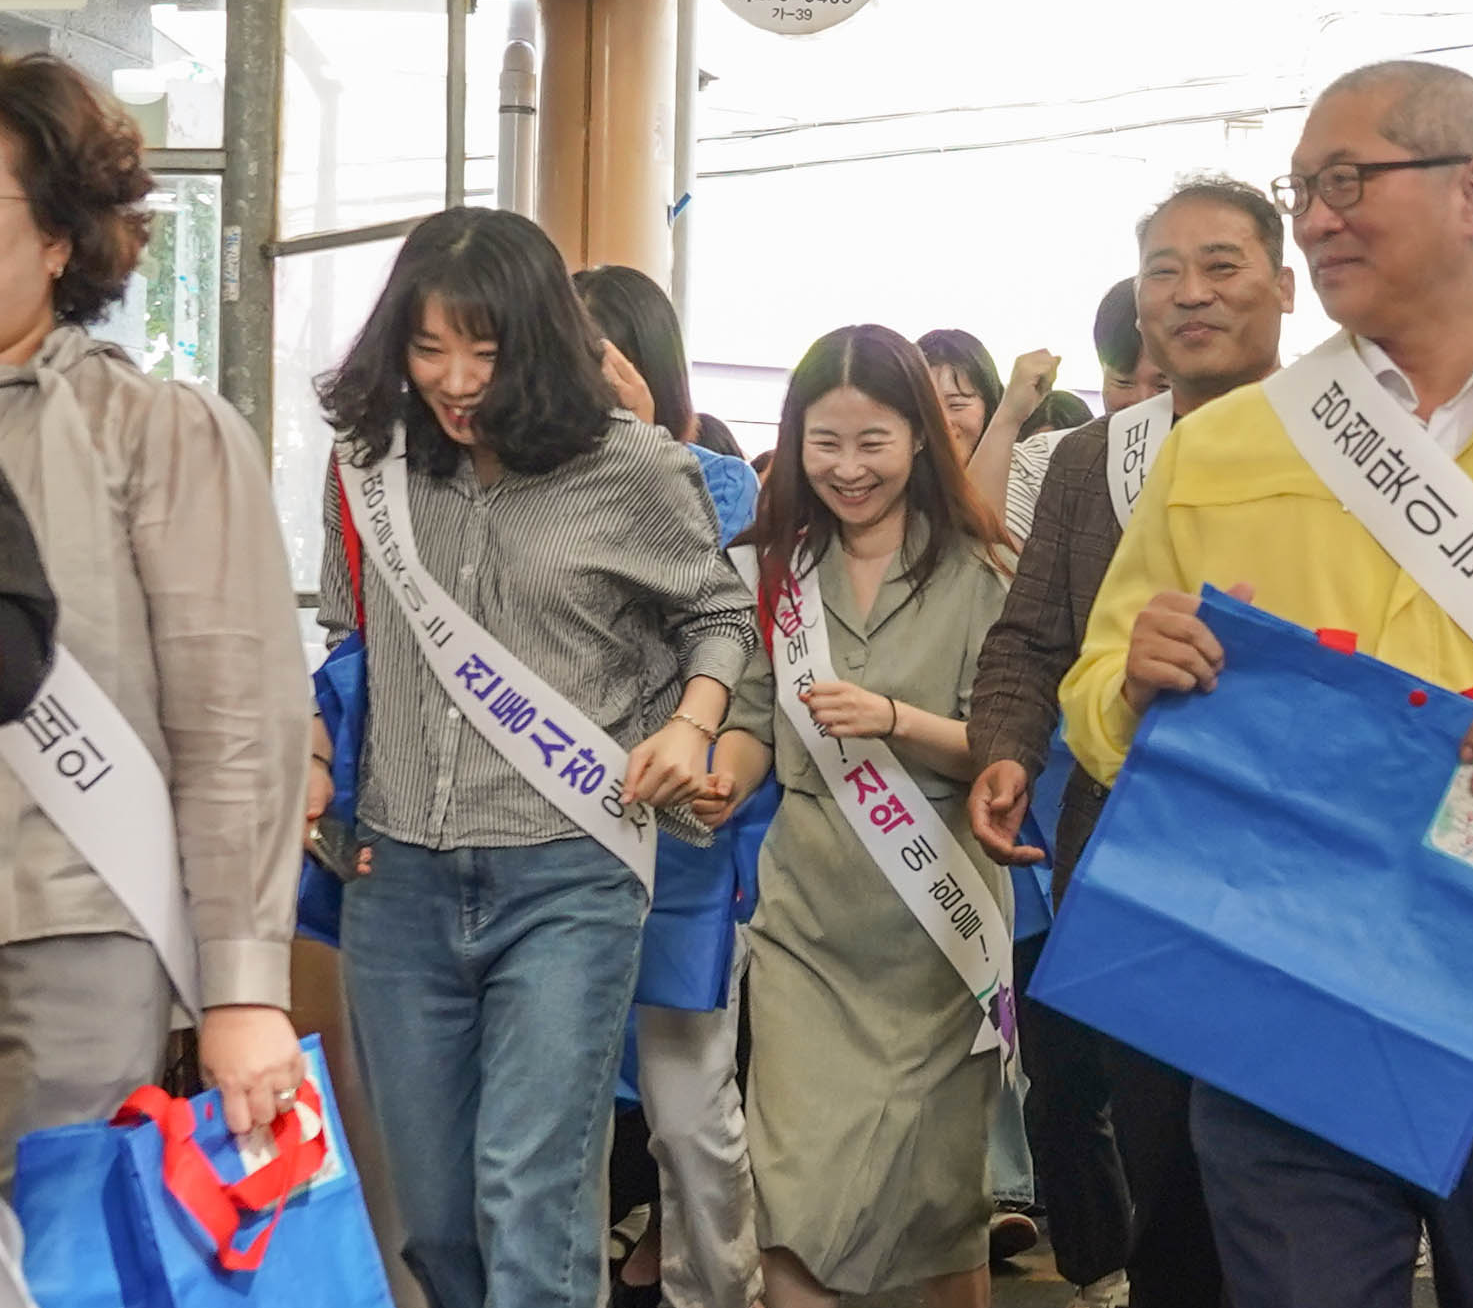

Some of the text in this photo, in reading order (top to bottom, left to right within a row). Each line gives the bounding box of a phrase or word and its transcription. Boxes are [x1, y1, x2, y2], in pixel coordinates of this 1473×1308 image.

[772, 7, 813, 21] 가-39
[361, 472, 454, 649] 명절맞이는
[927, 871, 991, 964] 힘을!
